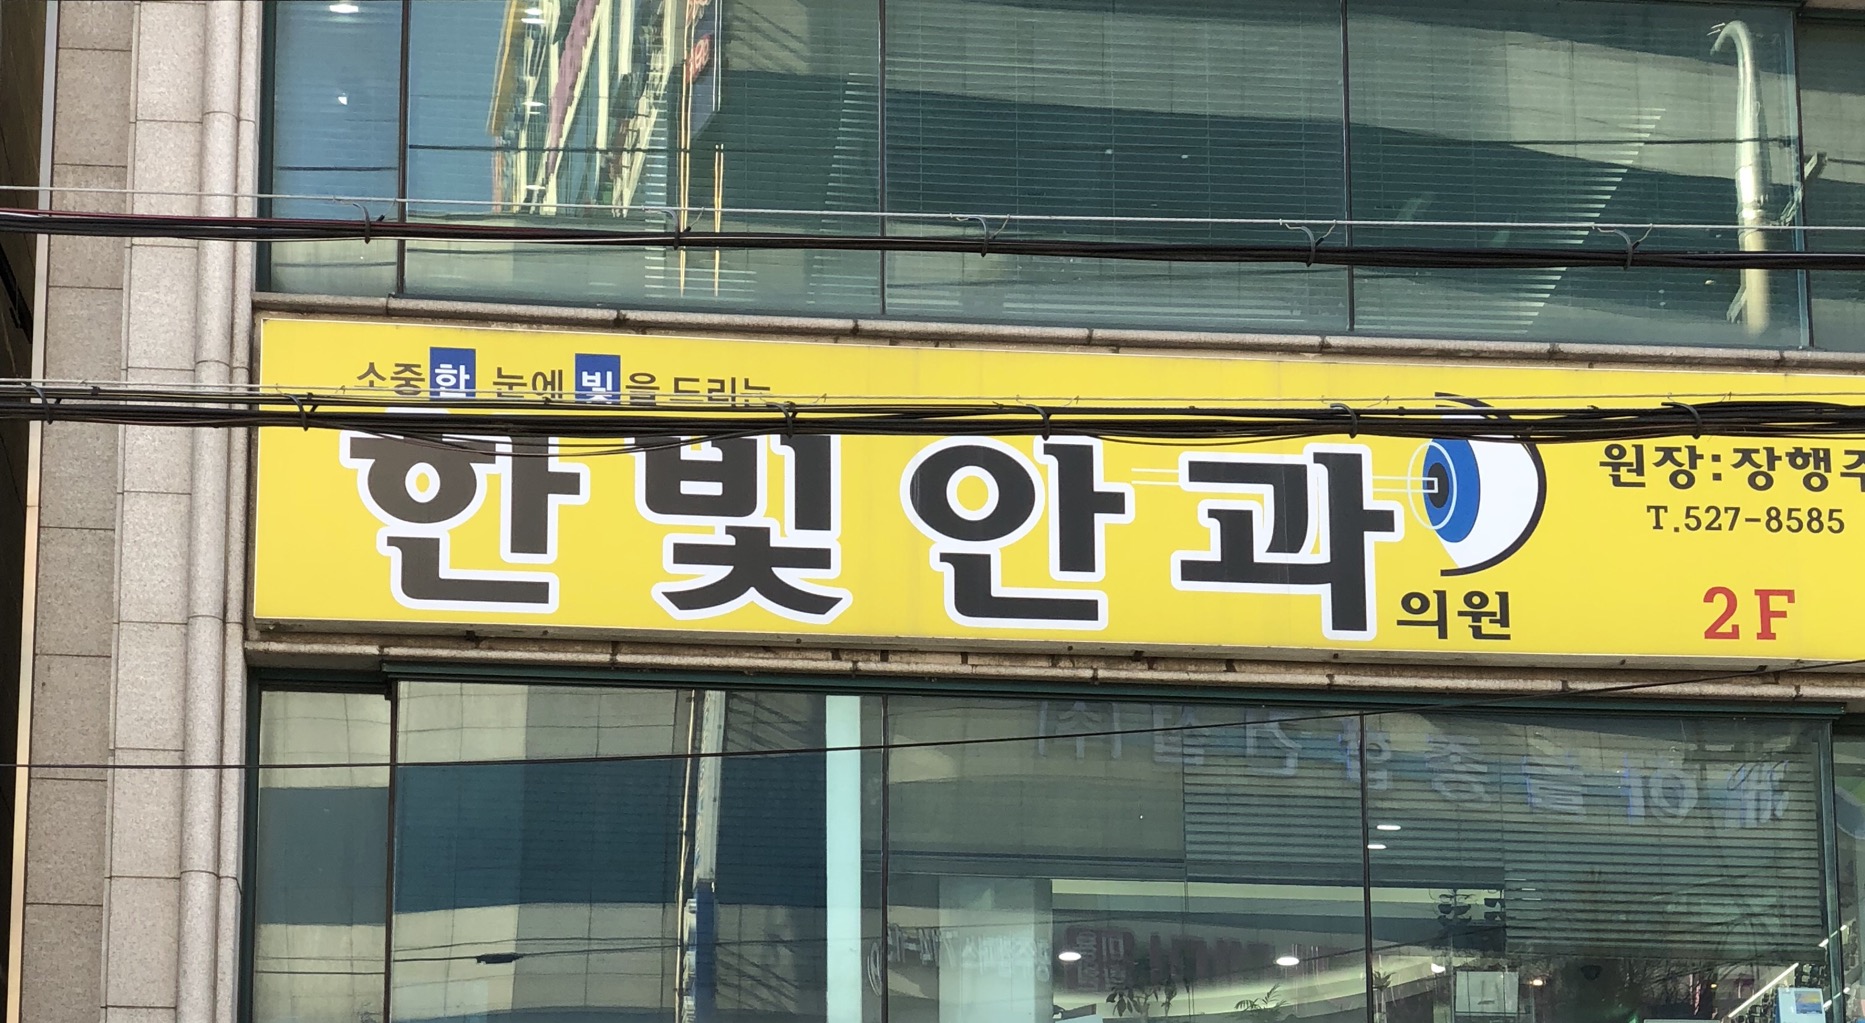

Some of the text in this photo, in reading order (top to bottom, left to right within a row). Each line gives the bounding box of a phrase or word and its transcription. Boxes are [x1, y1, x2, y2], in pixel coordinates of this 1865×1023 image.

[354, 362, 470, 398] 소중한
[1646, 504, 1845, 535] T.527-8585
[1397, 589, 1512, 641] 의원
[1702, 586, 1796, 641] 2F
